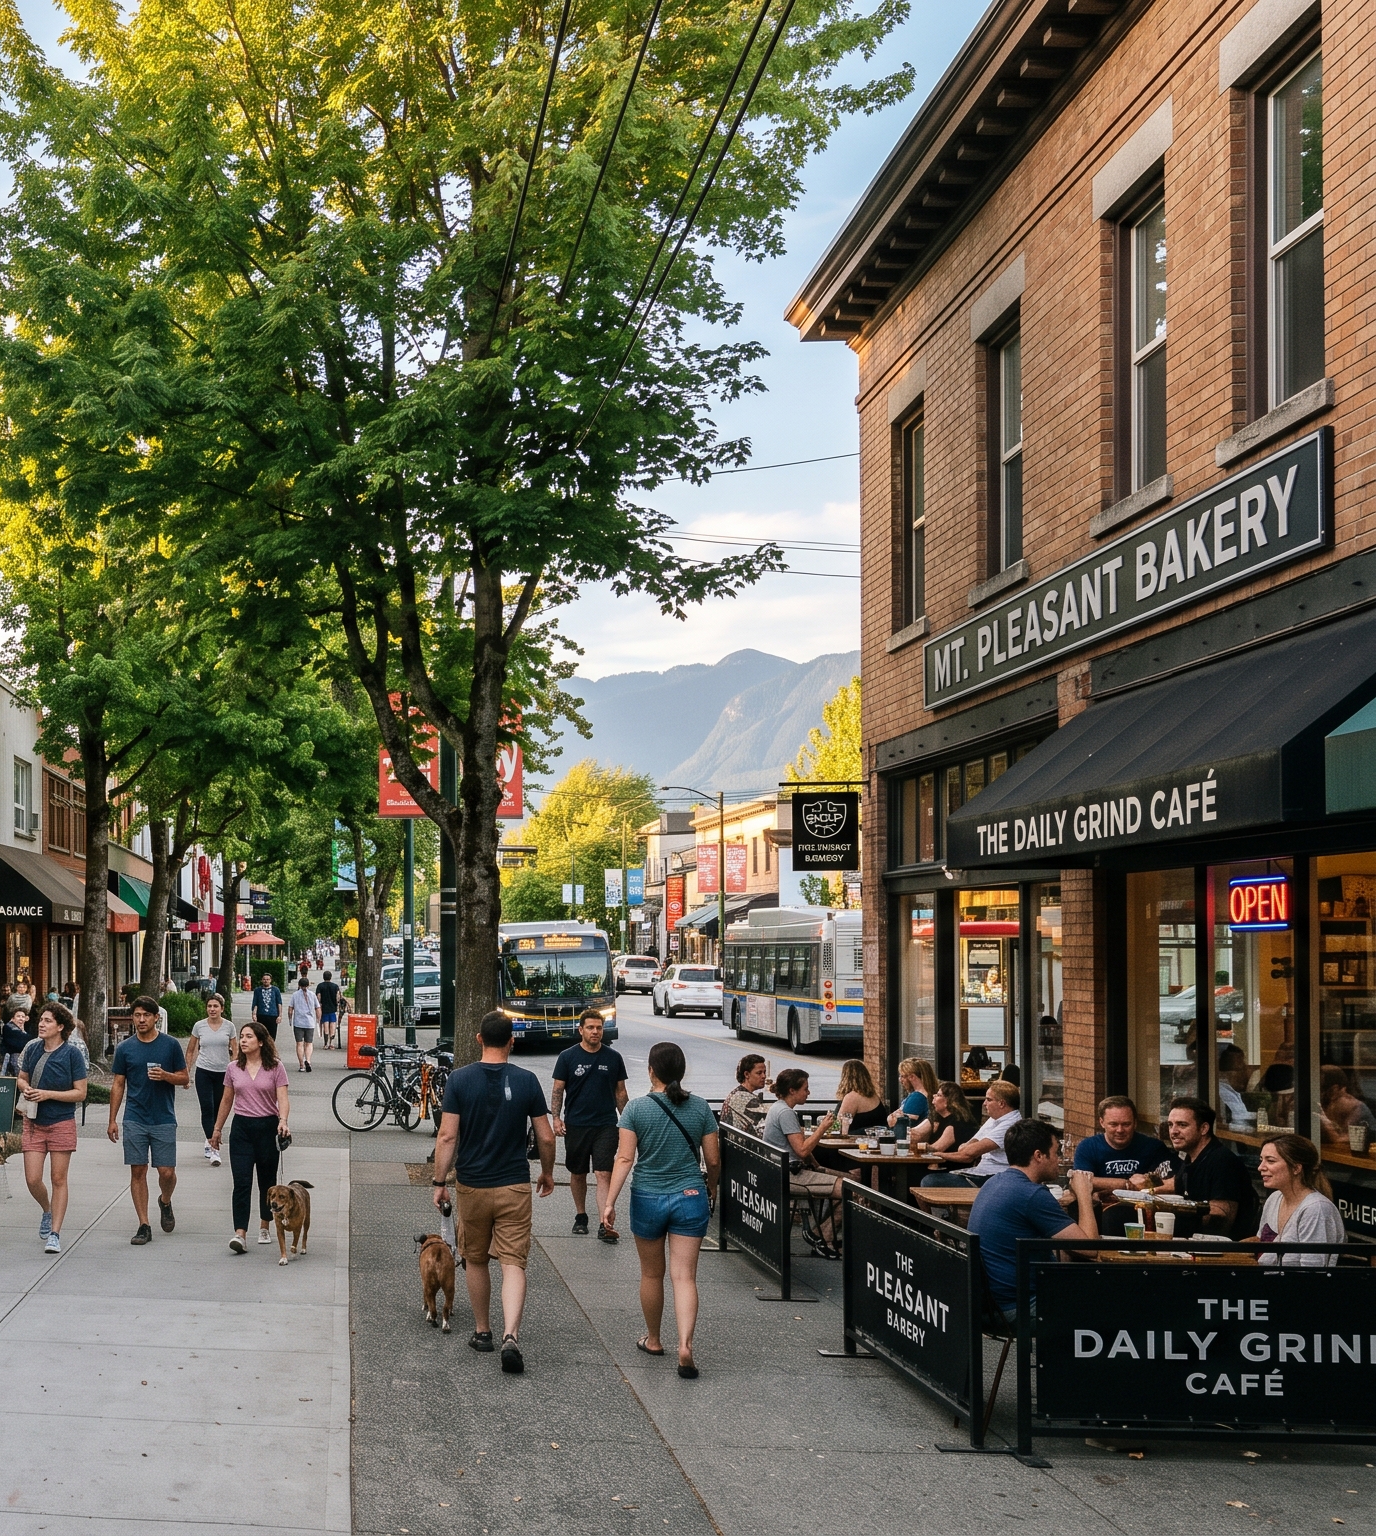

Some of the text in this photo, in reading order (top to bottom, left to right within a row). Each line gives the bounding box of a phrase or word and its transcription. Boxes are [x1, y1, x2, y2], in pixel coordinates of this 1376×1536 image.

[934, 464, 1299, 692] MT. PLEASANT BAKERY
[977, 768, 1217, 856] THE DAILY GRIND CAFÉ
[1229, 884, 1288, 923] OPEN
[747, 1170, 758, 1187] THE
[895, 1251, 914, 1277] THE
[866, 1261, 949, 1333] PLEASANT
[1197, 1298, 1269, 1321] THE
[887, 1307, 926, 1347] BARERY
[1074, 1329, 1376, 1364] DAILY GRIN
[1185, 1368, 1284, 1396] CAFÉ
